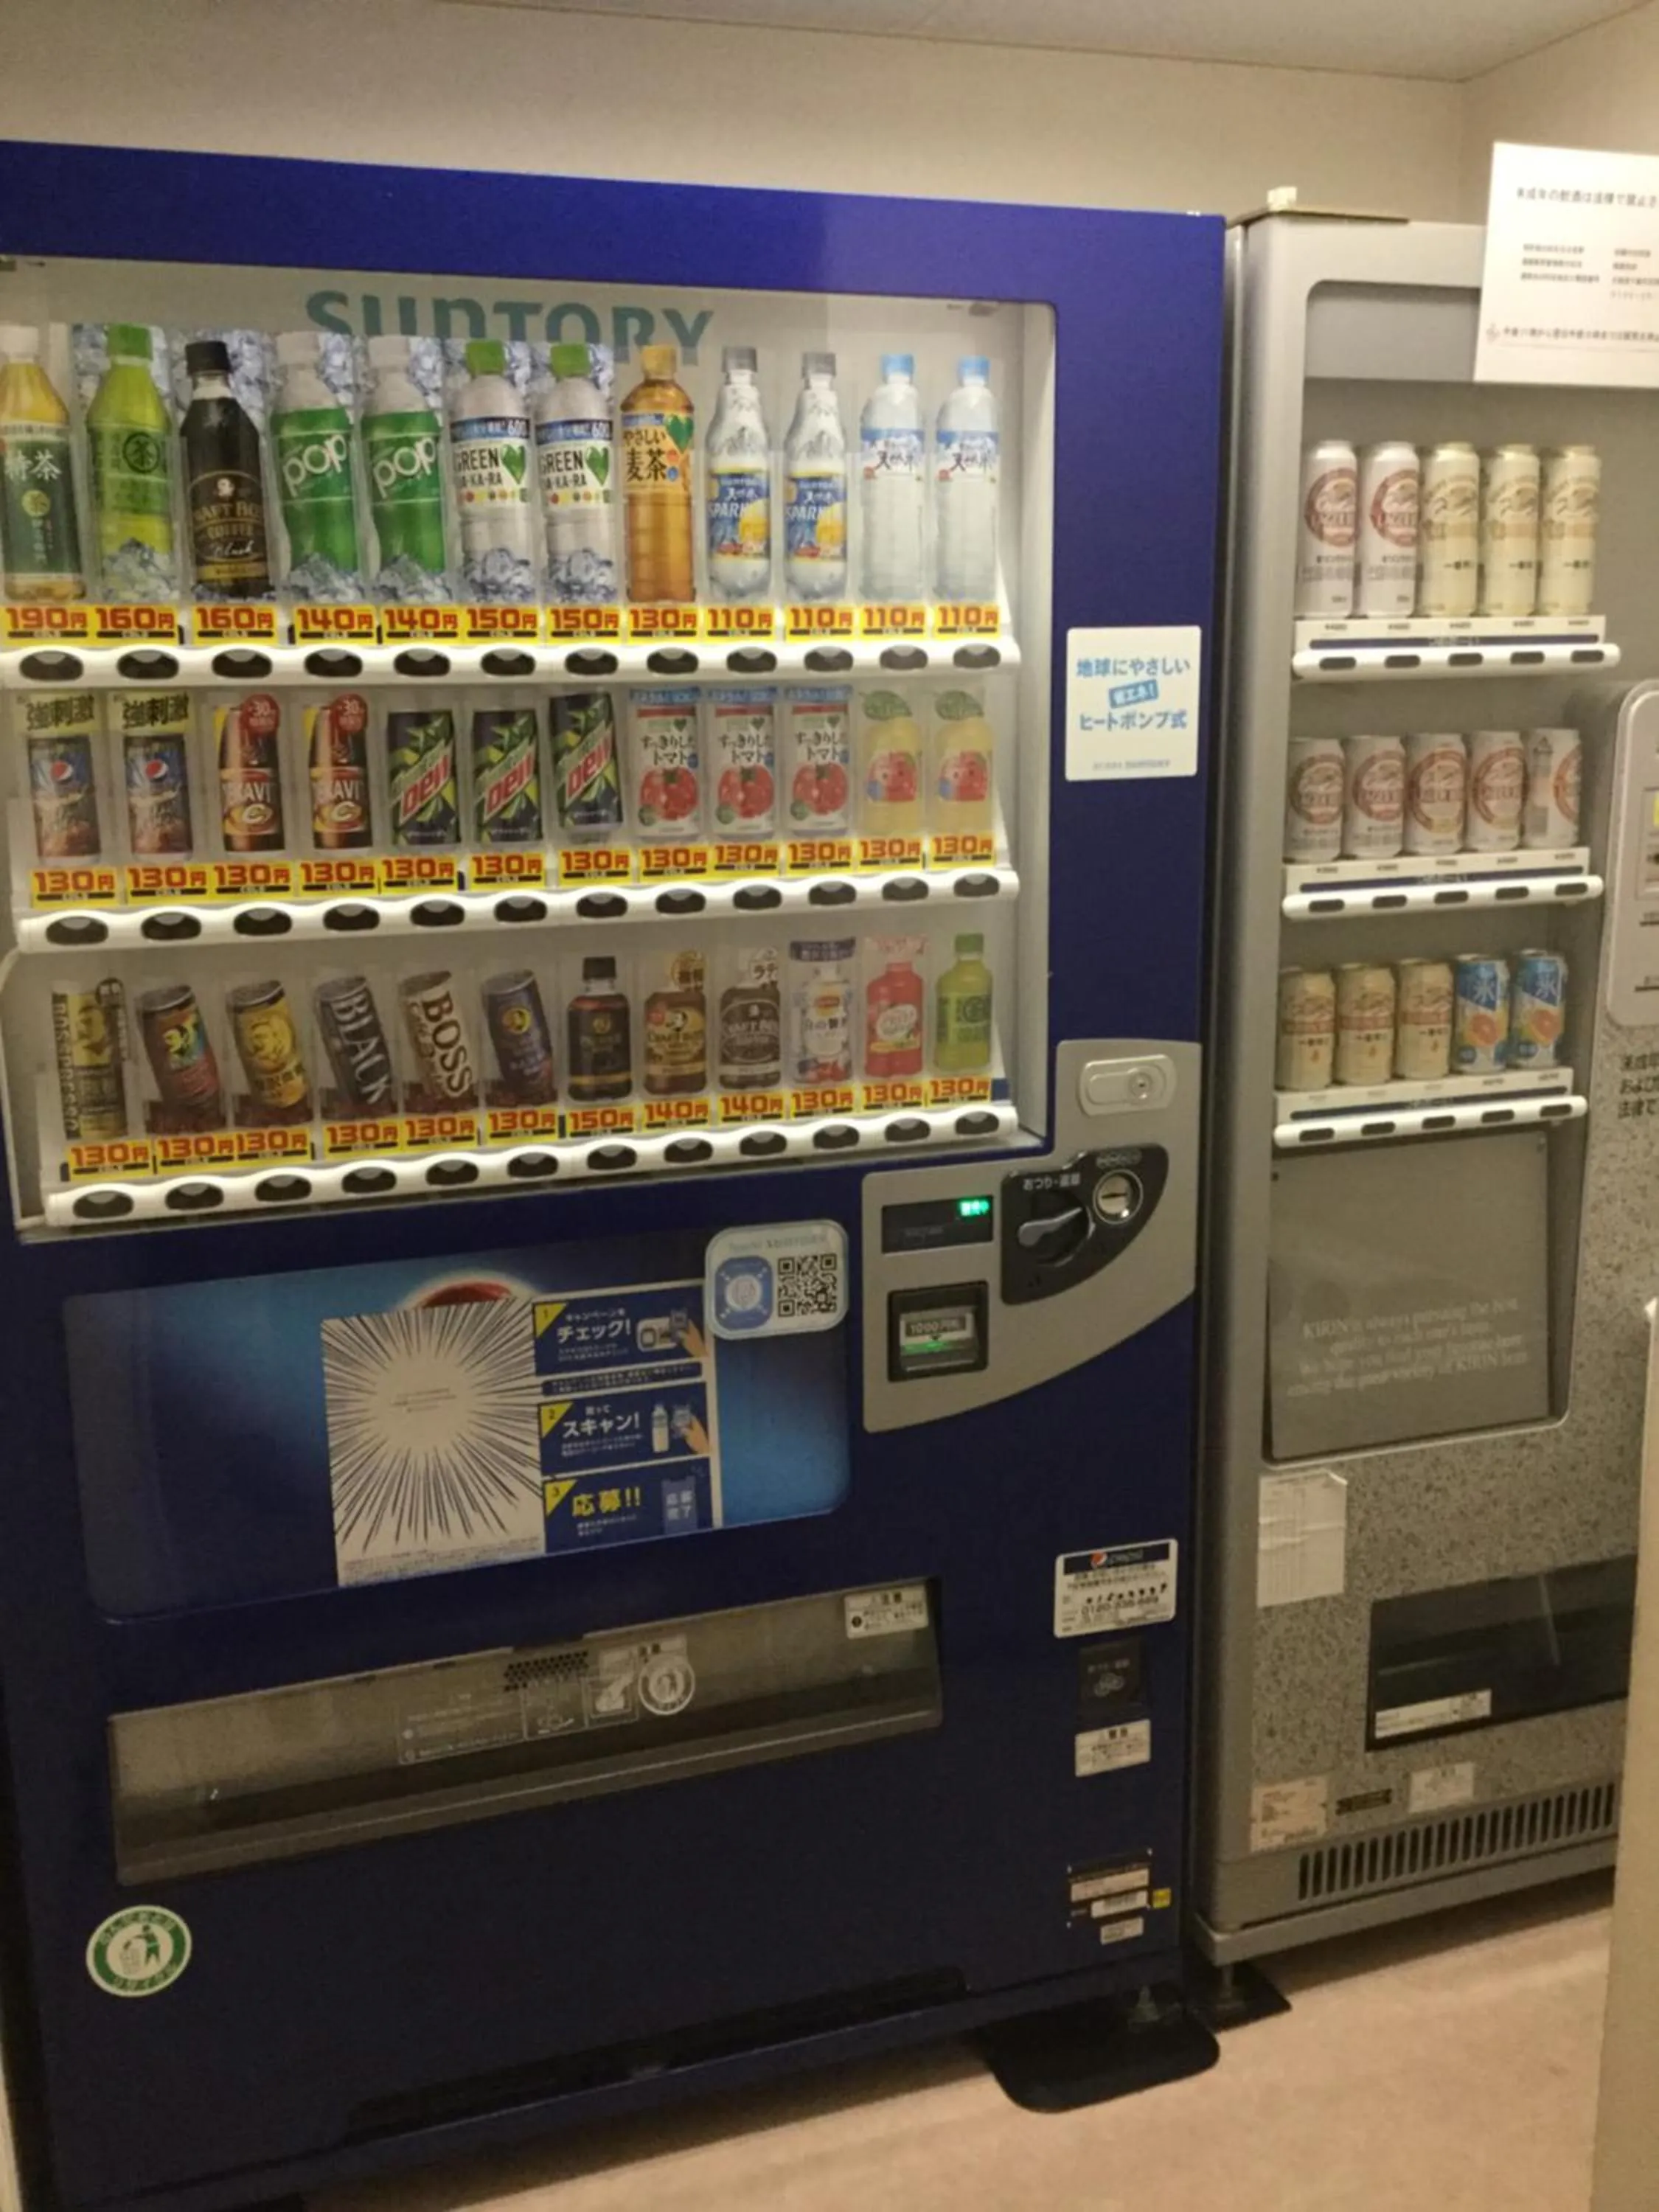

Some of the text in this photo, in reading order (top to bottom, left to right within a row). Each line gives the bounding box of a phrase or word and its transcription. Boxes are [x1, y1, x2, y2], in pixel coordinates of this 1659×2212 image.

[626, 448, 667, 483] 麦茶
[6, 608, 88, 629] 190円
[96, 608, 175, 629] 160円
[197, 607, 274, 629] 160円
[296, 608, 373, 630] 140円
[385, 608, 458, 630] 140円
[467, 608, 538, 630] 150円
[551, 608, 619, 629] 150円
[630, 608, 697, 628] 130円
[707, 608, 772, 628] 110円
[790, 608, 853, 627] 110円
[863, 607, 925, 627] 110円
[938, 606, 998, 626] 110円
[1077, 656, 1191, 678] 地球にやさしい
[1079, 709, 1188, 731] ヒートポンプ式
[714, 844, 777, 863] 130円
[788, 842, 852, 861] 130円
[860, 838, 920, 858] 130円
[932, 835, 992, 855] 130円
[382, 858, 455, 879] 130円
[472, 854, 542, 876] 130円
[560, 850, 628, 871] 130円
[641, 848, 706, 868] 130円
[34, 871, 114, 892] 130円
[128, 867, 207, 888] 130円
[213, 864, 291, 886] 130円
[300, 860, 375, 883] 130円
[332, 992, 392, 1104] BLACK
[421, 990, 473, 1098] BOSS
[863, 1081, 922, 1102] 130円
[930, 1077, 990, 1097] 130円
[721, 1093, 782, 1115] 140円
[792, 1088, 853, 1110] 130円
[490, 1110, 555, 1132] 130円
[568, 1106, 633, 1128] 150円
[645, 1101, 709, 1122] 140円
[327, 1122, 397, 1144] 130円
[406, 1117, 475, 1139] 130円
[158, 1137, 233, 1159] 130円
[237, 1130, 307, 1152] 130円
[72, 1144, 147, 1166] 130円
[563, 1411, 640, 1439] スキャン!
